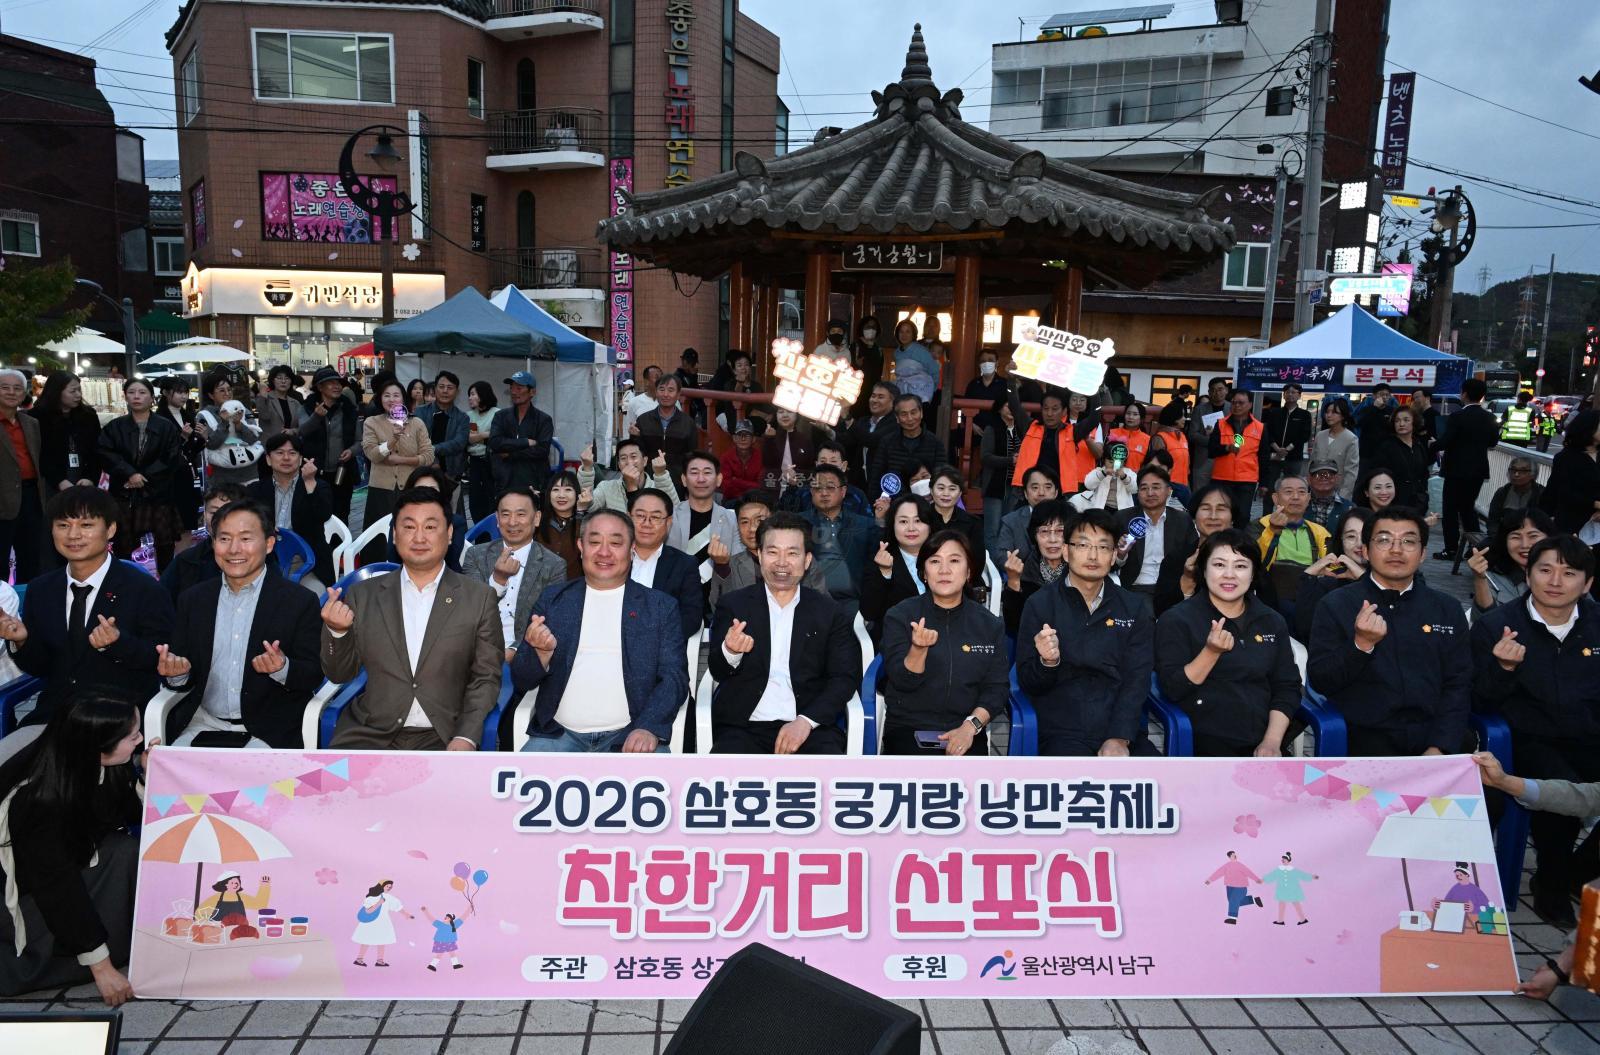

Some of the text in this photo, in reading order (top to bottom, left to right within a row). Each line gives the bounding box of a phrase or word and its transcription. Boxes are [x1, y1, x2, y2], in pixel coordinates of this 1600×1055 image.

[303, 285, 381, 304] 귀빈식당
[1355, 367, 1424, 383] 본부석
[685, 781, 816, 828] 삼호동
[834, 781, 964, 829] 궁거랑
[562, 848, 1118, 933] 착한거리 선포식
[540, 956, 587, 980] 주관
[614, 956, 684, 980] 삼호동
[902, 955, 947, 979] 후원
[1021, 955, 1156, 976] 울산광역시 남구
